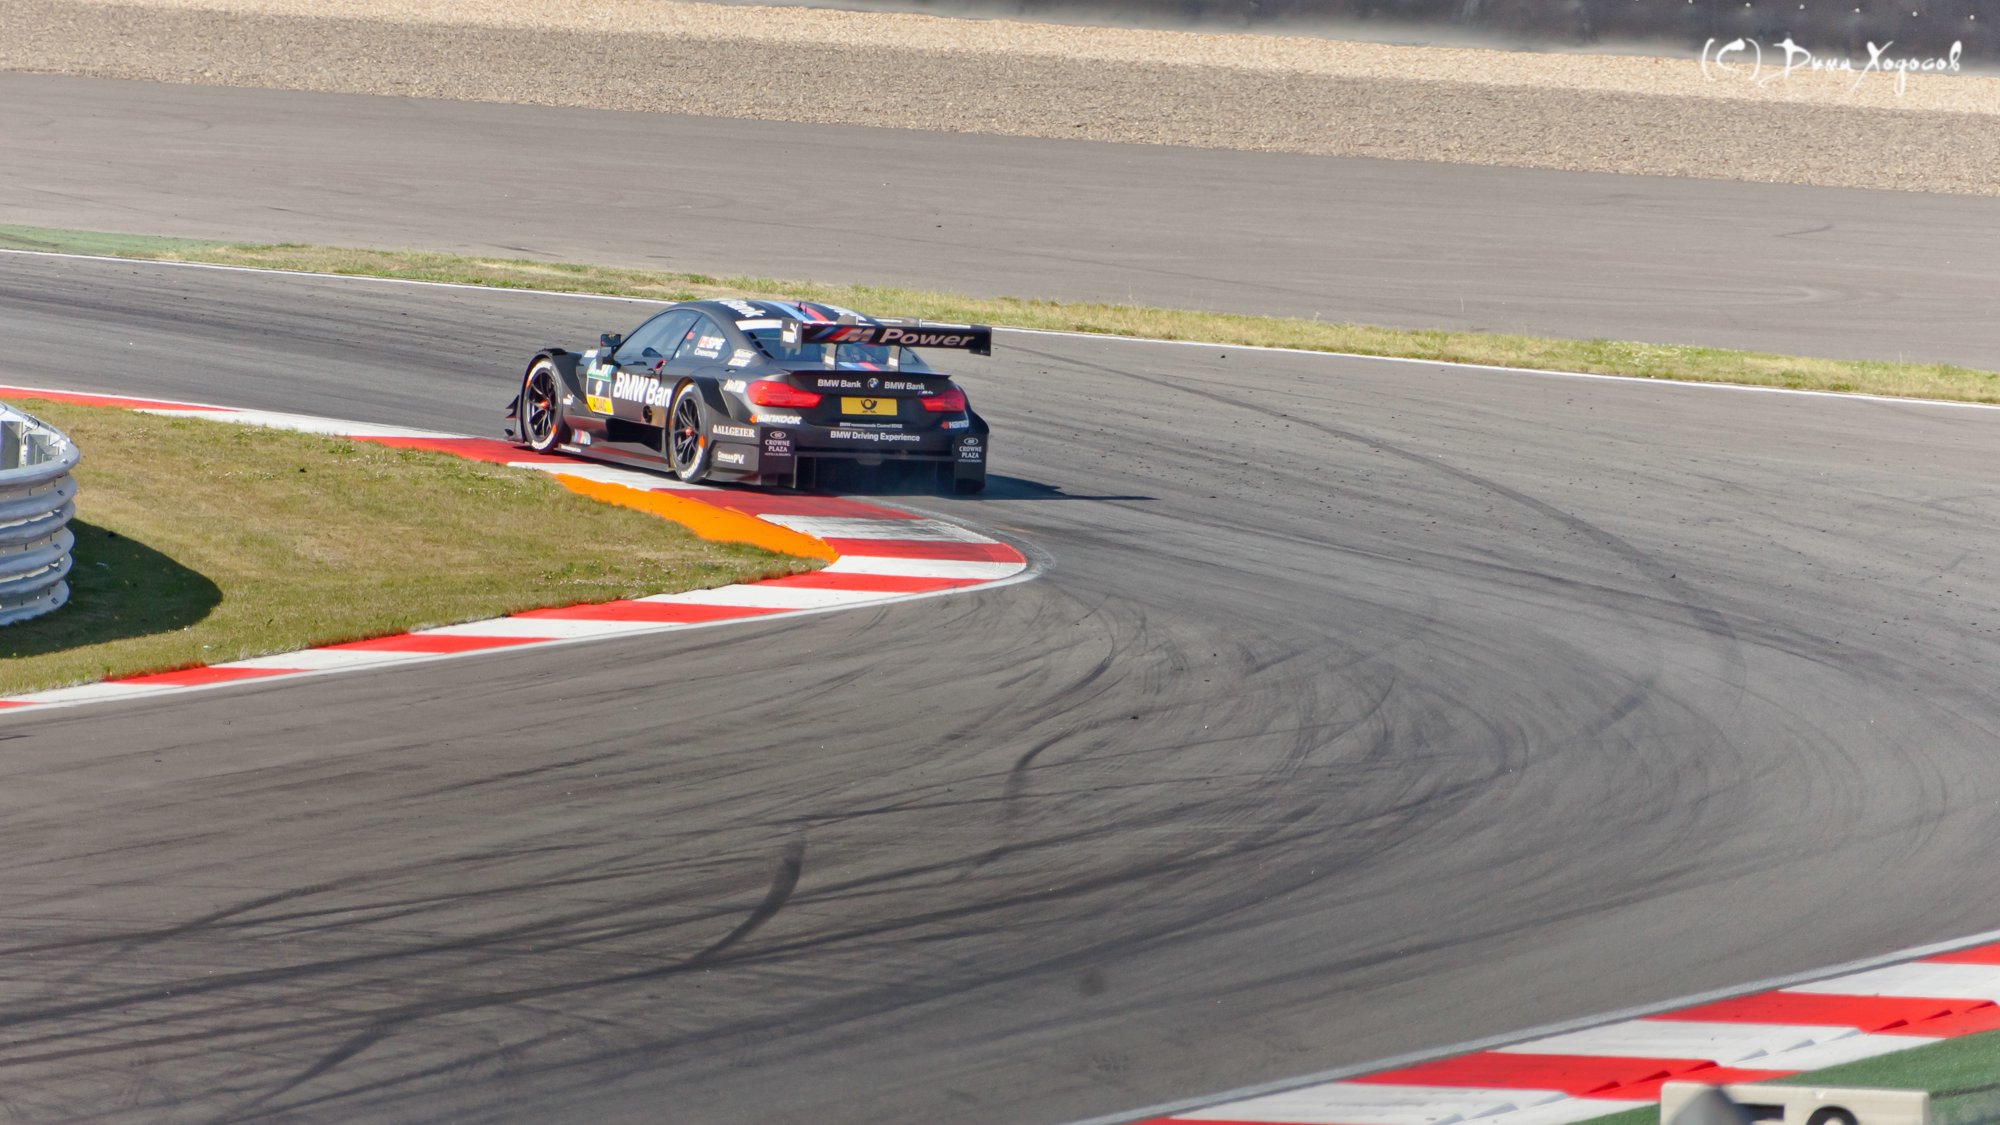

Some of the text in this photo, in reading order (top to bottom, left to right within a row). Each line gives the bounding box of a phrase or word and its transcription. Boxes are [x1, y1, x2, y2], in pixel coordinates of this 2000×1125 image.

[880, 328, 976, 347] Power
[595, 380, 603, 397] 9
[613, 371, 650, 403] BMW
[817, 378, 861, 389] BMW Bank
[884, 381, 925, 391] BMW Bank
[716, 424, 755, 438] ALLGEIER
[830, 430, 921, 442] BMW Driving Experience
[764, 439, 791, 447] CROWNE
[768, 445, 788, 453] PLAZA
